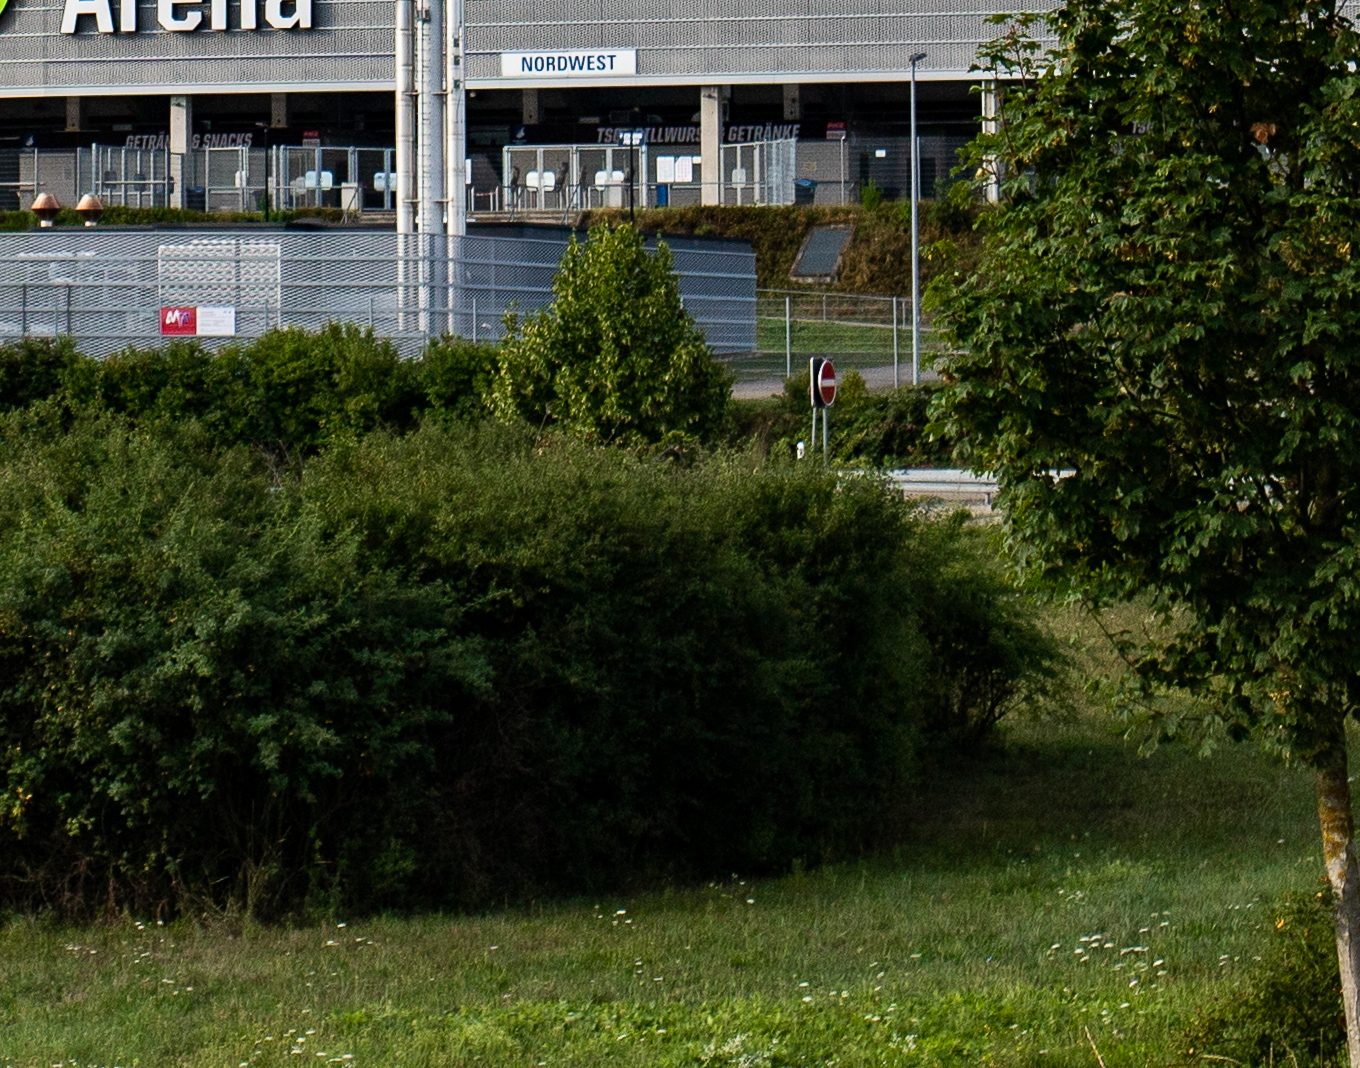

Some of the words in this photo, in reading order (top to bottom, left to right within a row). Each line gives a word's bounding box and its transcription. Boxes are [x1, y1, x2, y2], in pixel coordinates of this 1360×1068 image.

[521, 54, 617, 72] NORDWEST
[202, 133, 253, 149] SNACKS
[726, 122, 802, 142] GETRÄNKE
